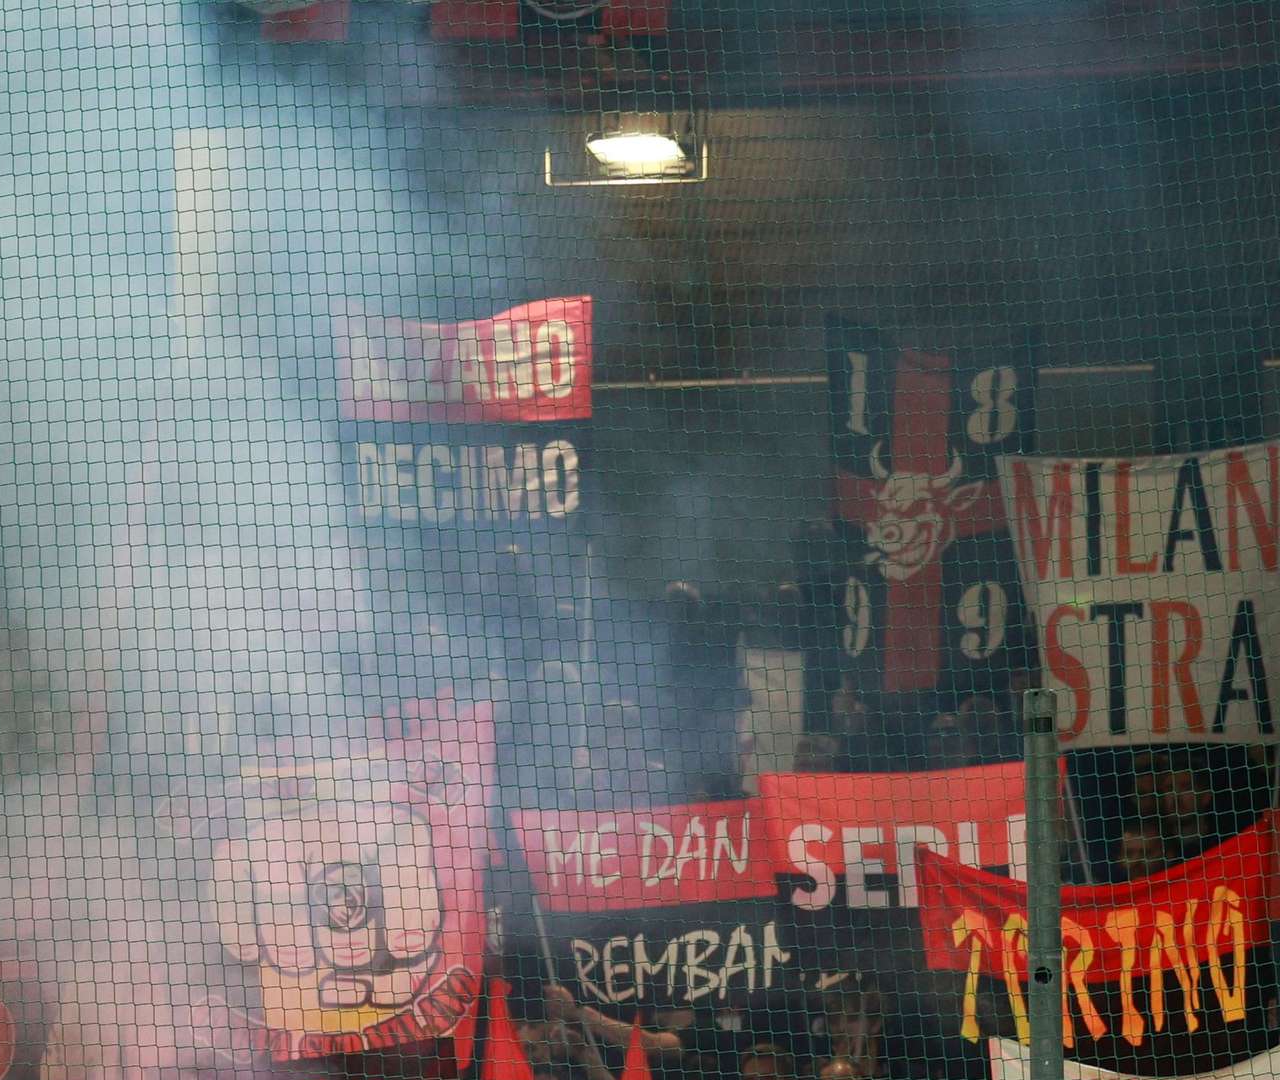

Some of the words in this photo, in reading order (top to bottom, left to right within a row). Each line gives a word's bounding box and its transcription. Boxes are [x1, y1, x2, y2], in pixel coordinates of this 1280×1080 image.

[358, 440, 580, 521] DECIMO
[1012, 445, 1280, 580] MILAN
[1045, 598, 1274, 741] STRA
[640, 812, 752, 890] DAN
